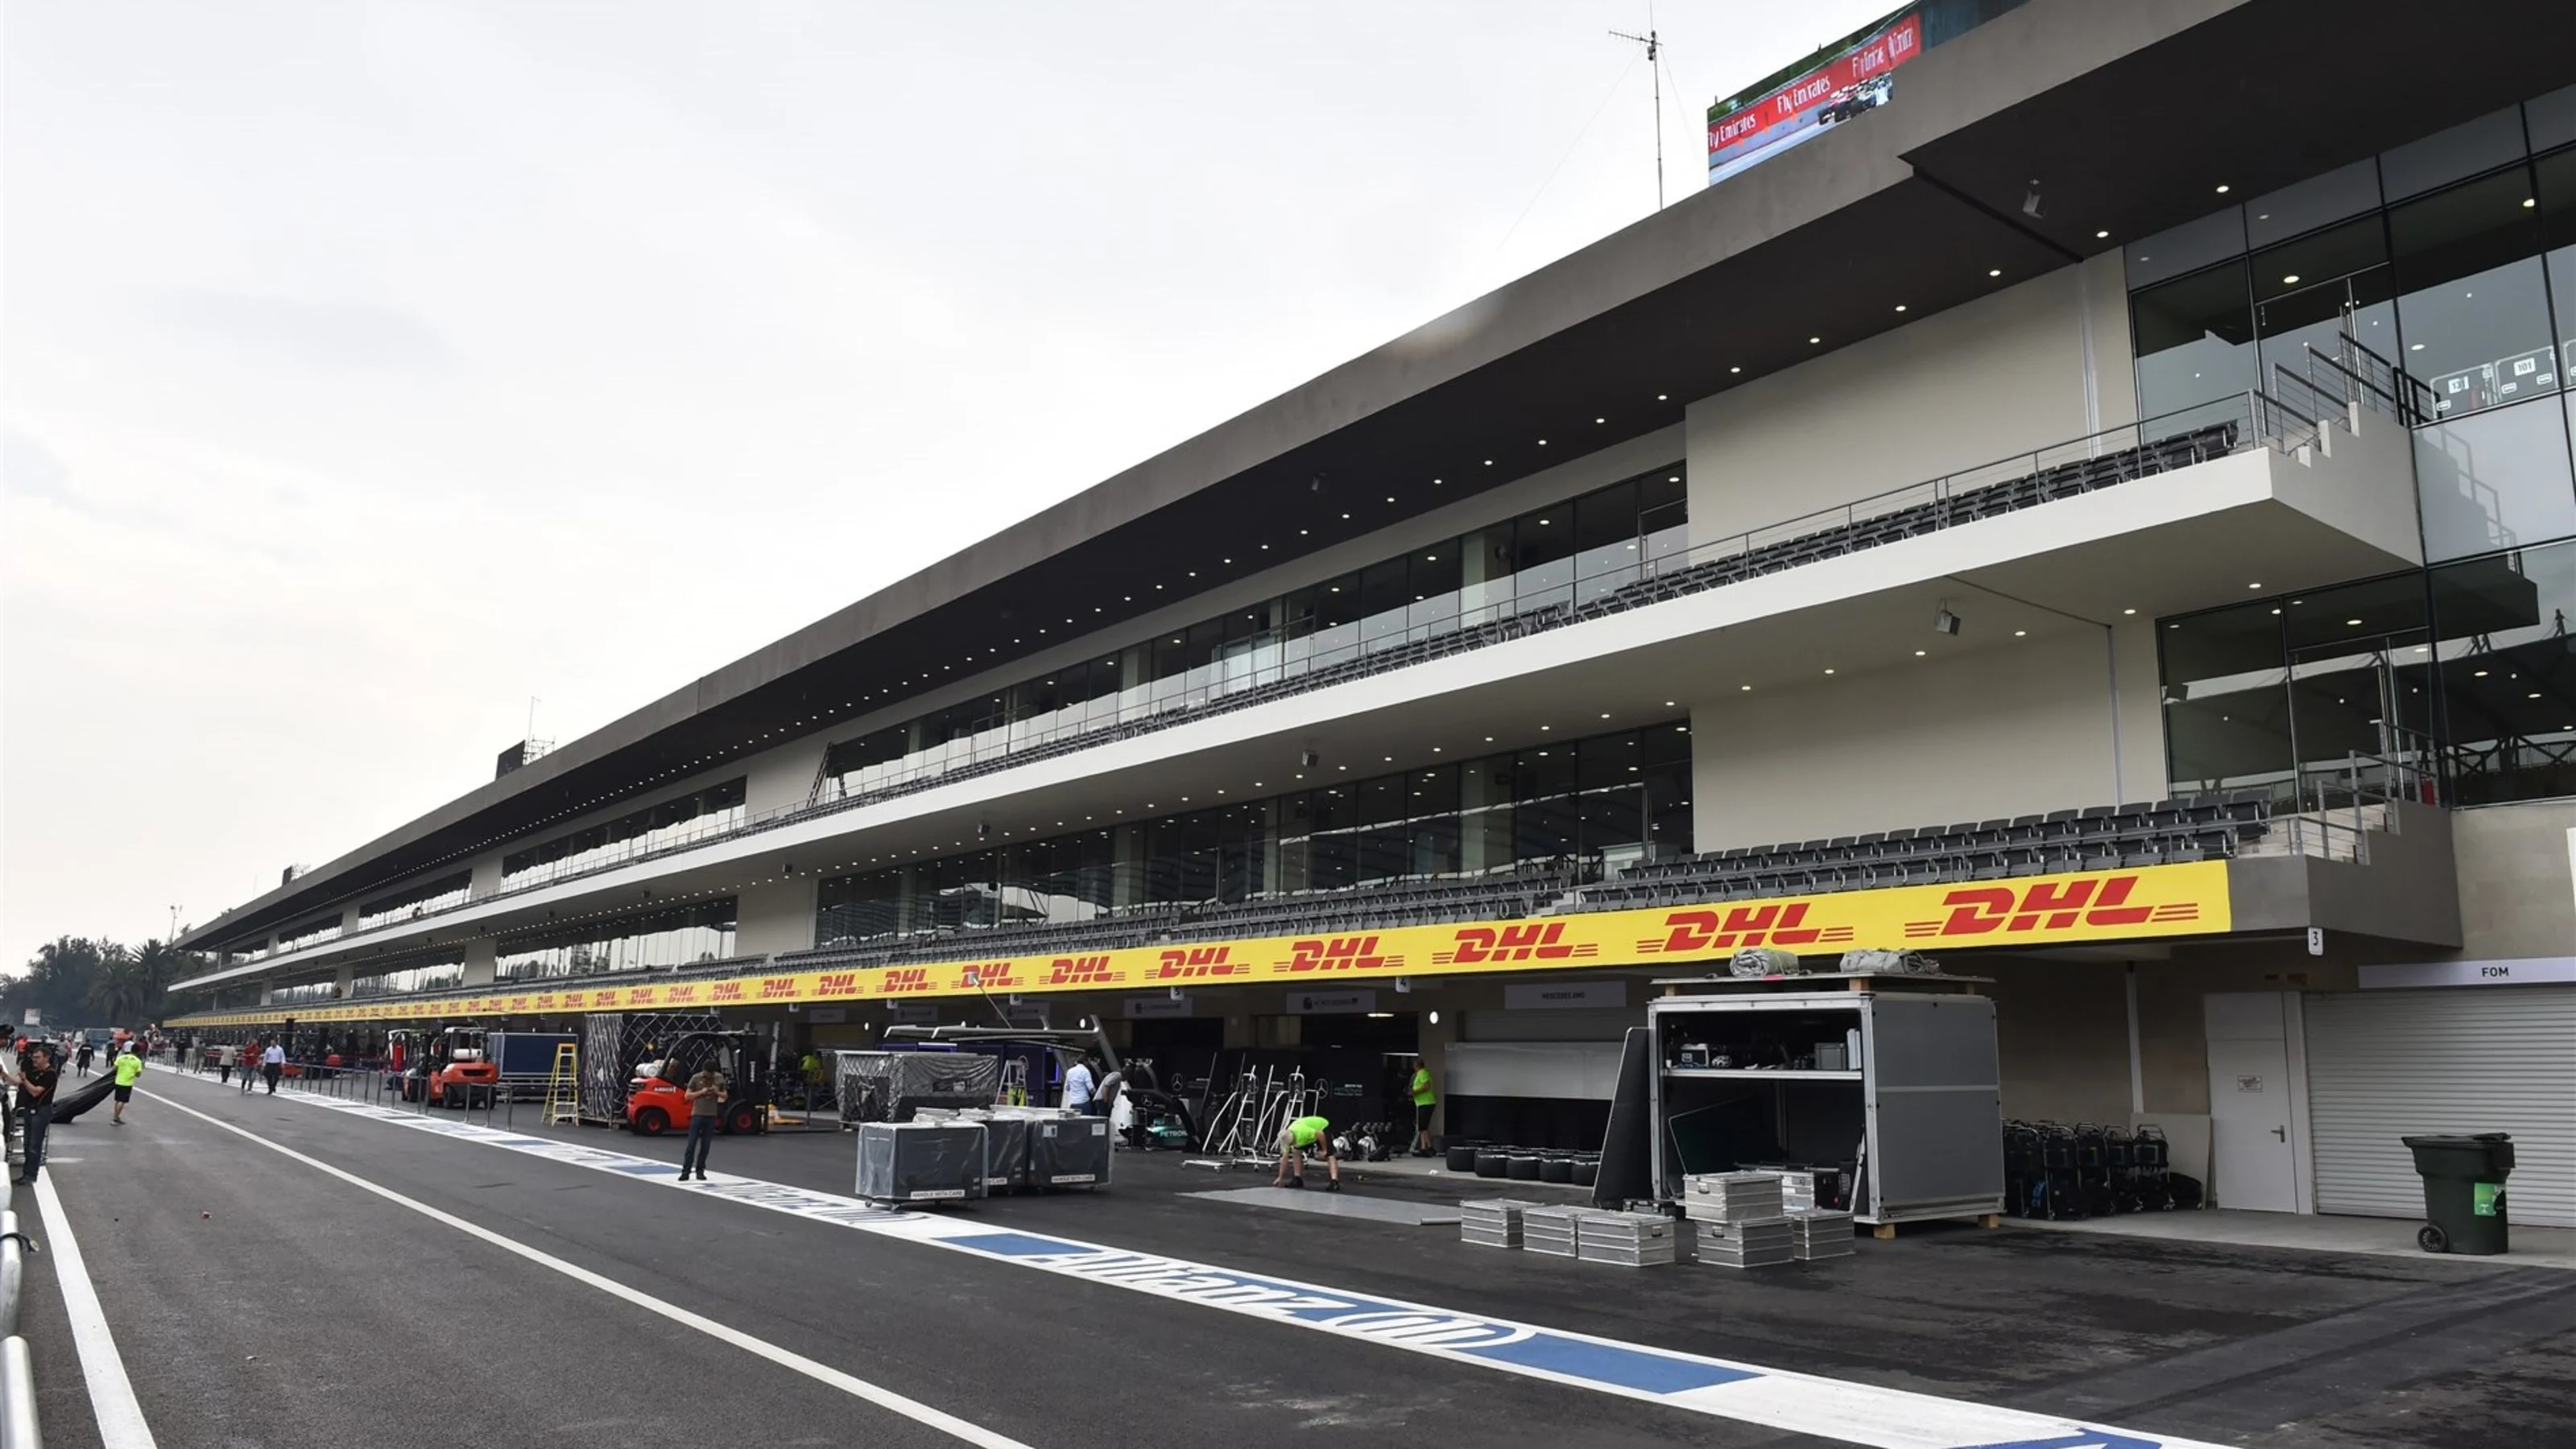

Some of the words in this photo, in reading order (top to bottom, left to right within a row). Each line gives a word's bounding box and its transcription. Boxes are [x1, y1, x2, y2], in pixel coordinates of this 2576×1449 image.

[630, 988, 653, 1005] DHL
[668, 985, 694, 1003] DHL
[712, 982, 742, 1001] DHL
[762, 979, 796, 998] DHL
[818, 975, 857, 995] DHL
[884, 969, 928, 992] DHL
[961, 963, 1013, 989] DHL
[1050, 956, 1114, 985] DHL
[1158, 947, 1237, 979] DHL
[1290, 937, 1385, 971] DHL
[1453, 923, 1577, 963] DHL
[1664, 903, 1821, 952] DHL
[1941, 876, 2154, 935] DHL
[2313, 931, 2319, 947] 3
[2481, 966, 2509, 977] FOM
[1400, 978, 1407, 987] 4
[1016, 1253, 1358, 1315] Allianz
